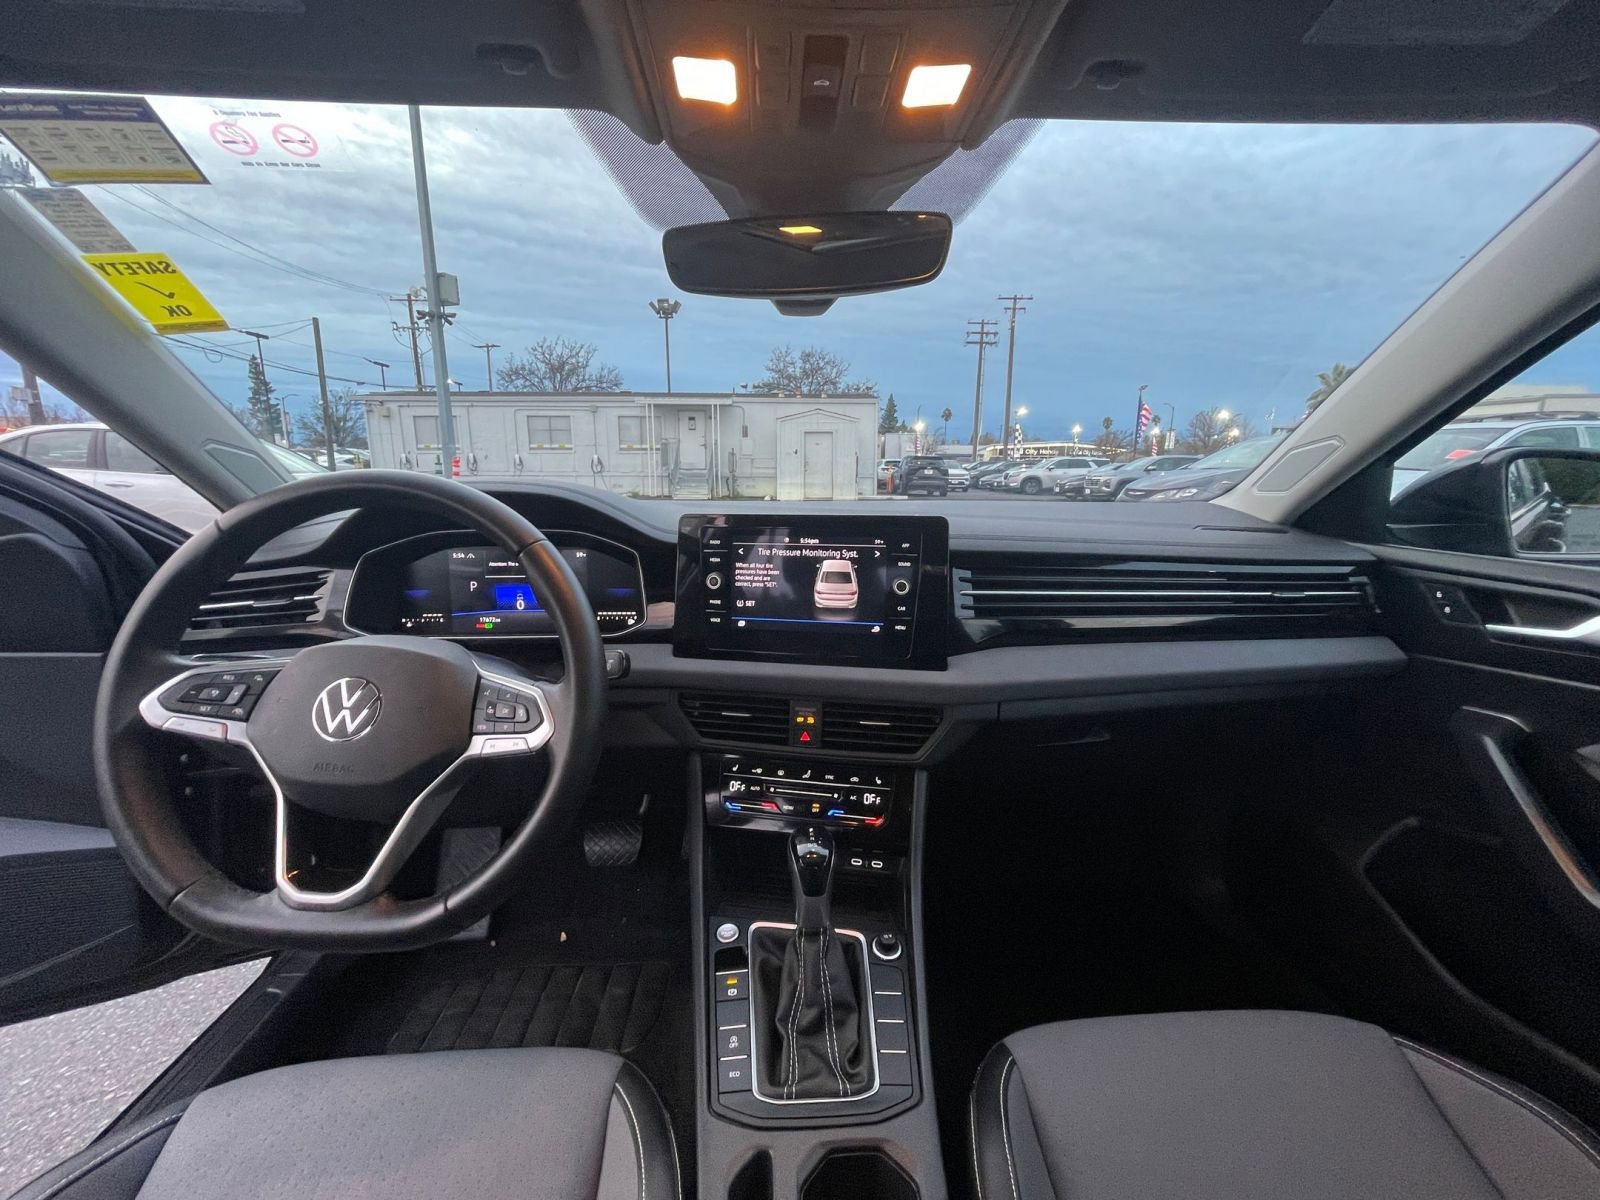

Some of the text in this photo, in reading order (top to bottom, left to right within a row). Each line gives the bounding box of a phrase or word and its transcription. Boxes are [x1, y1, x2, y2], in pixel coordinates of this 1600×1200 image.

[758, 548, 858, 559] Tire Pressure Monitoring Syst.
[470, 581, 478, 591] P
[516, 600, 524, 610] 0
